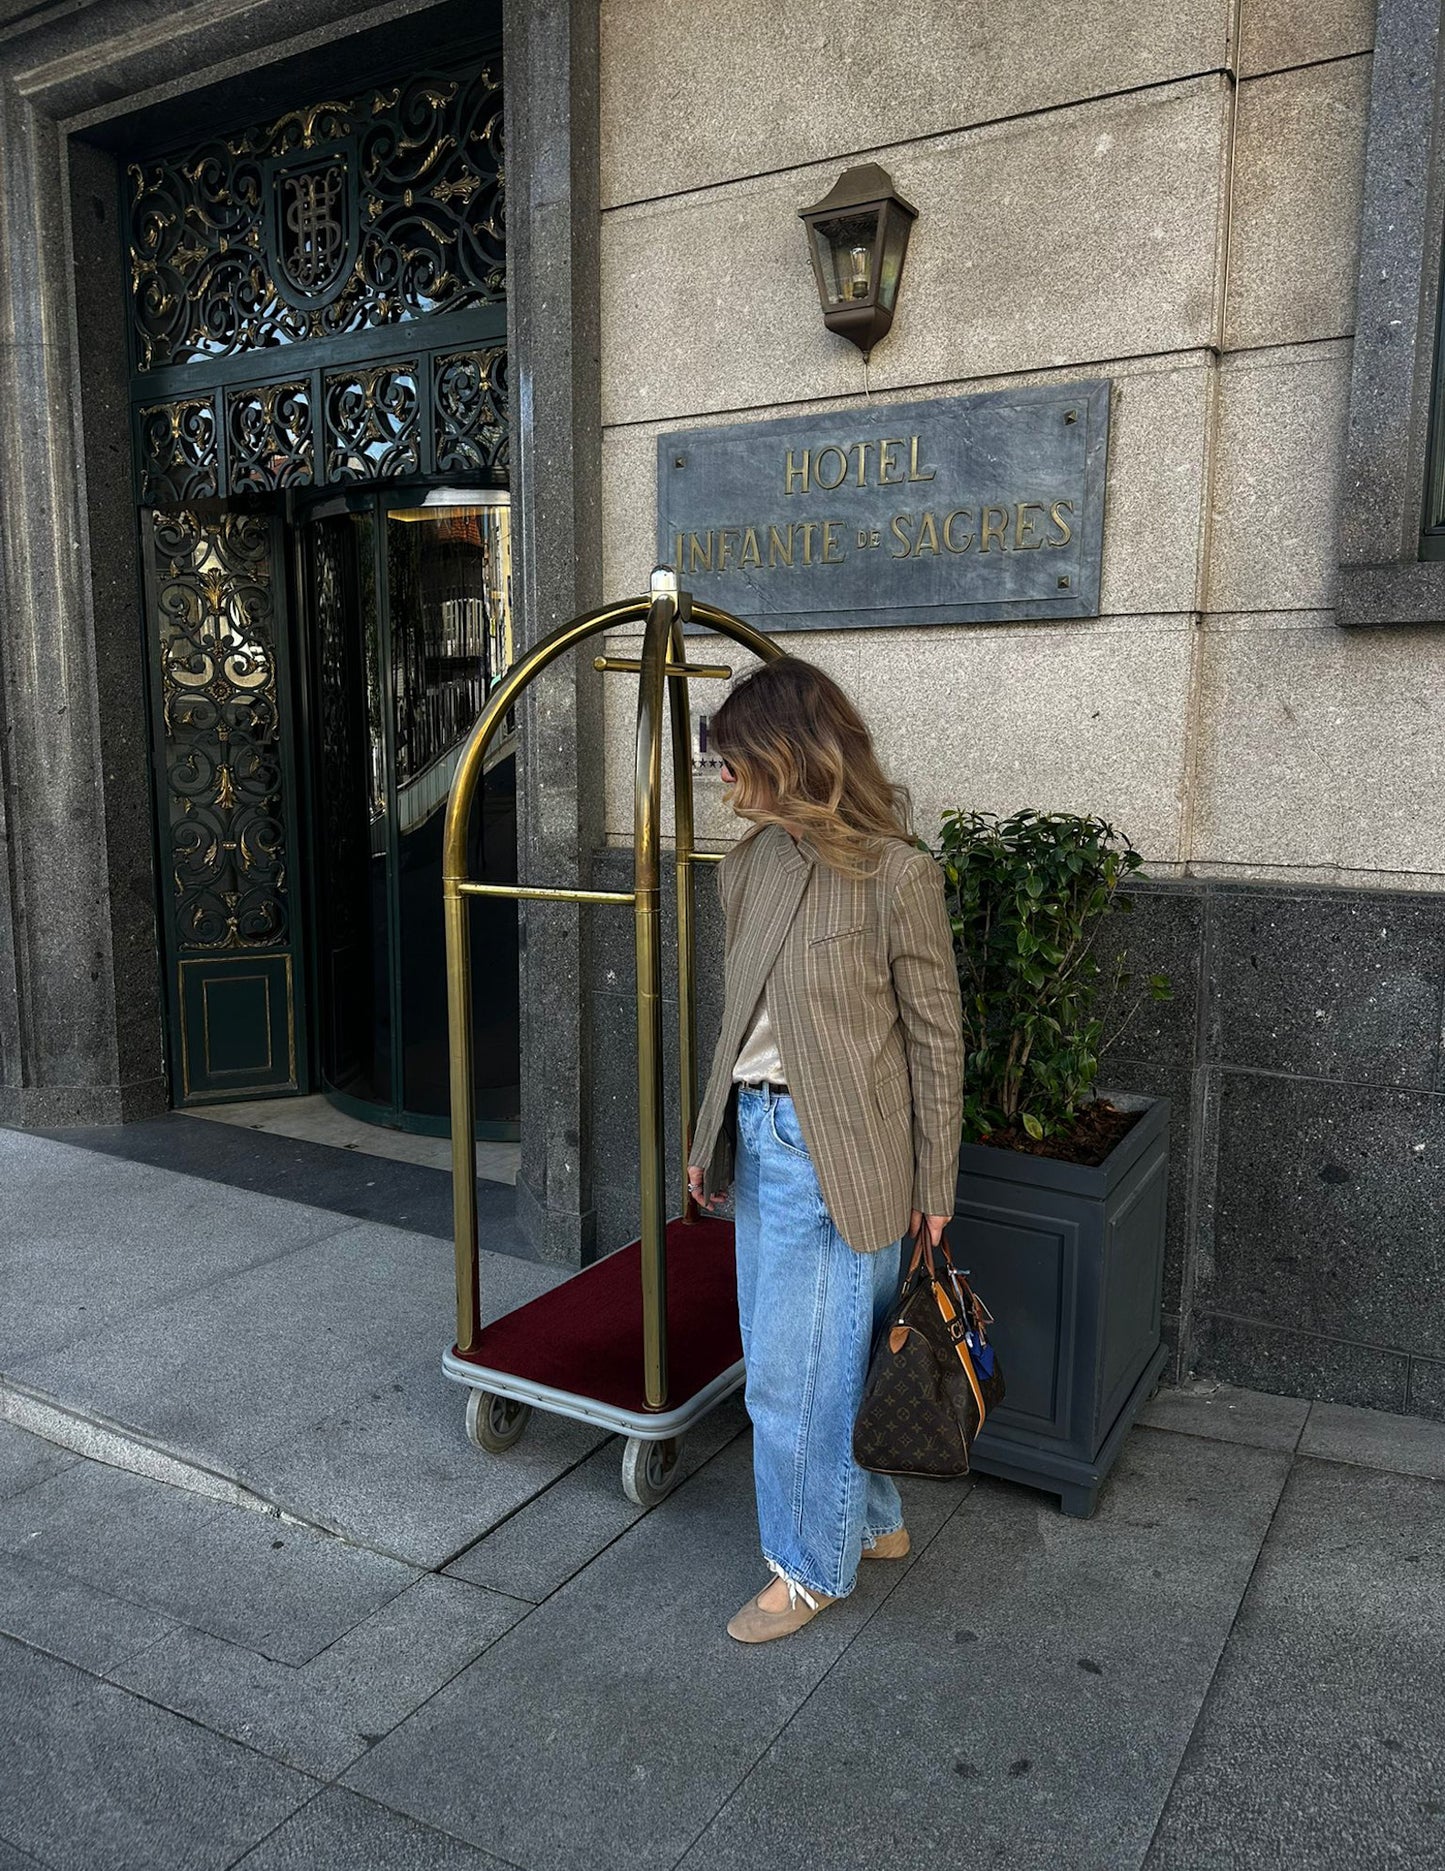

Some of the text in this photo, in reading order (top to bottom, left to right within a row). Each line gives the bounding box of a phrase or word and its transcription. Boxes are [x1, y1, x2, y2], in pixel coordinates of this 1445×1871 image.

[784, 435, 937, 495] HOTEL
[675, 500, 1074, 574] INFANTE DE SAGRES
